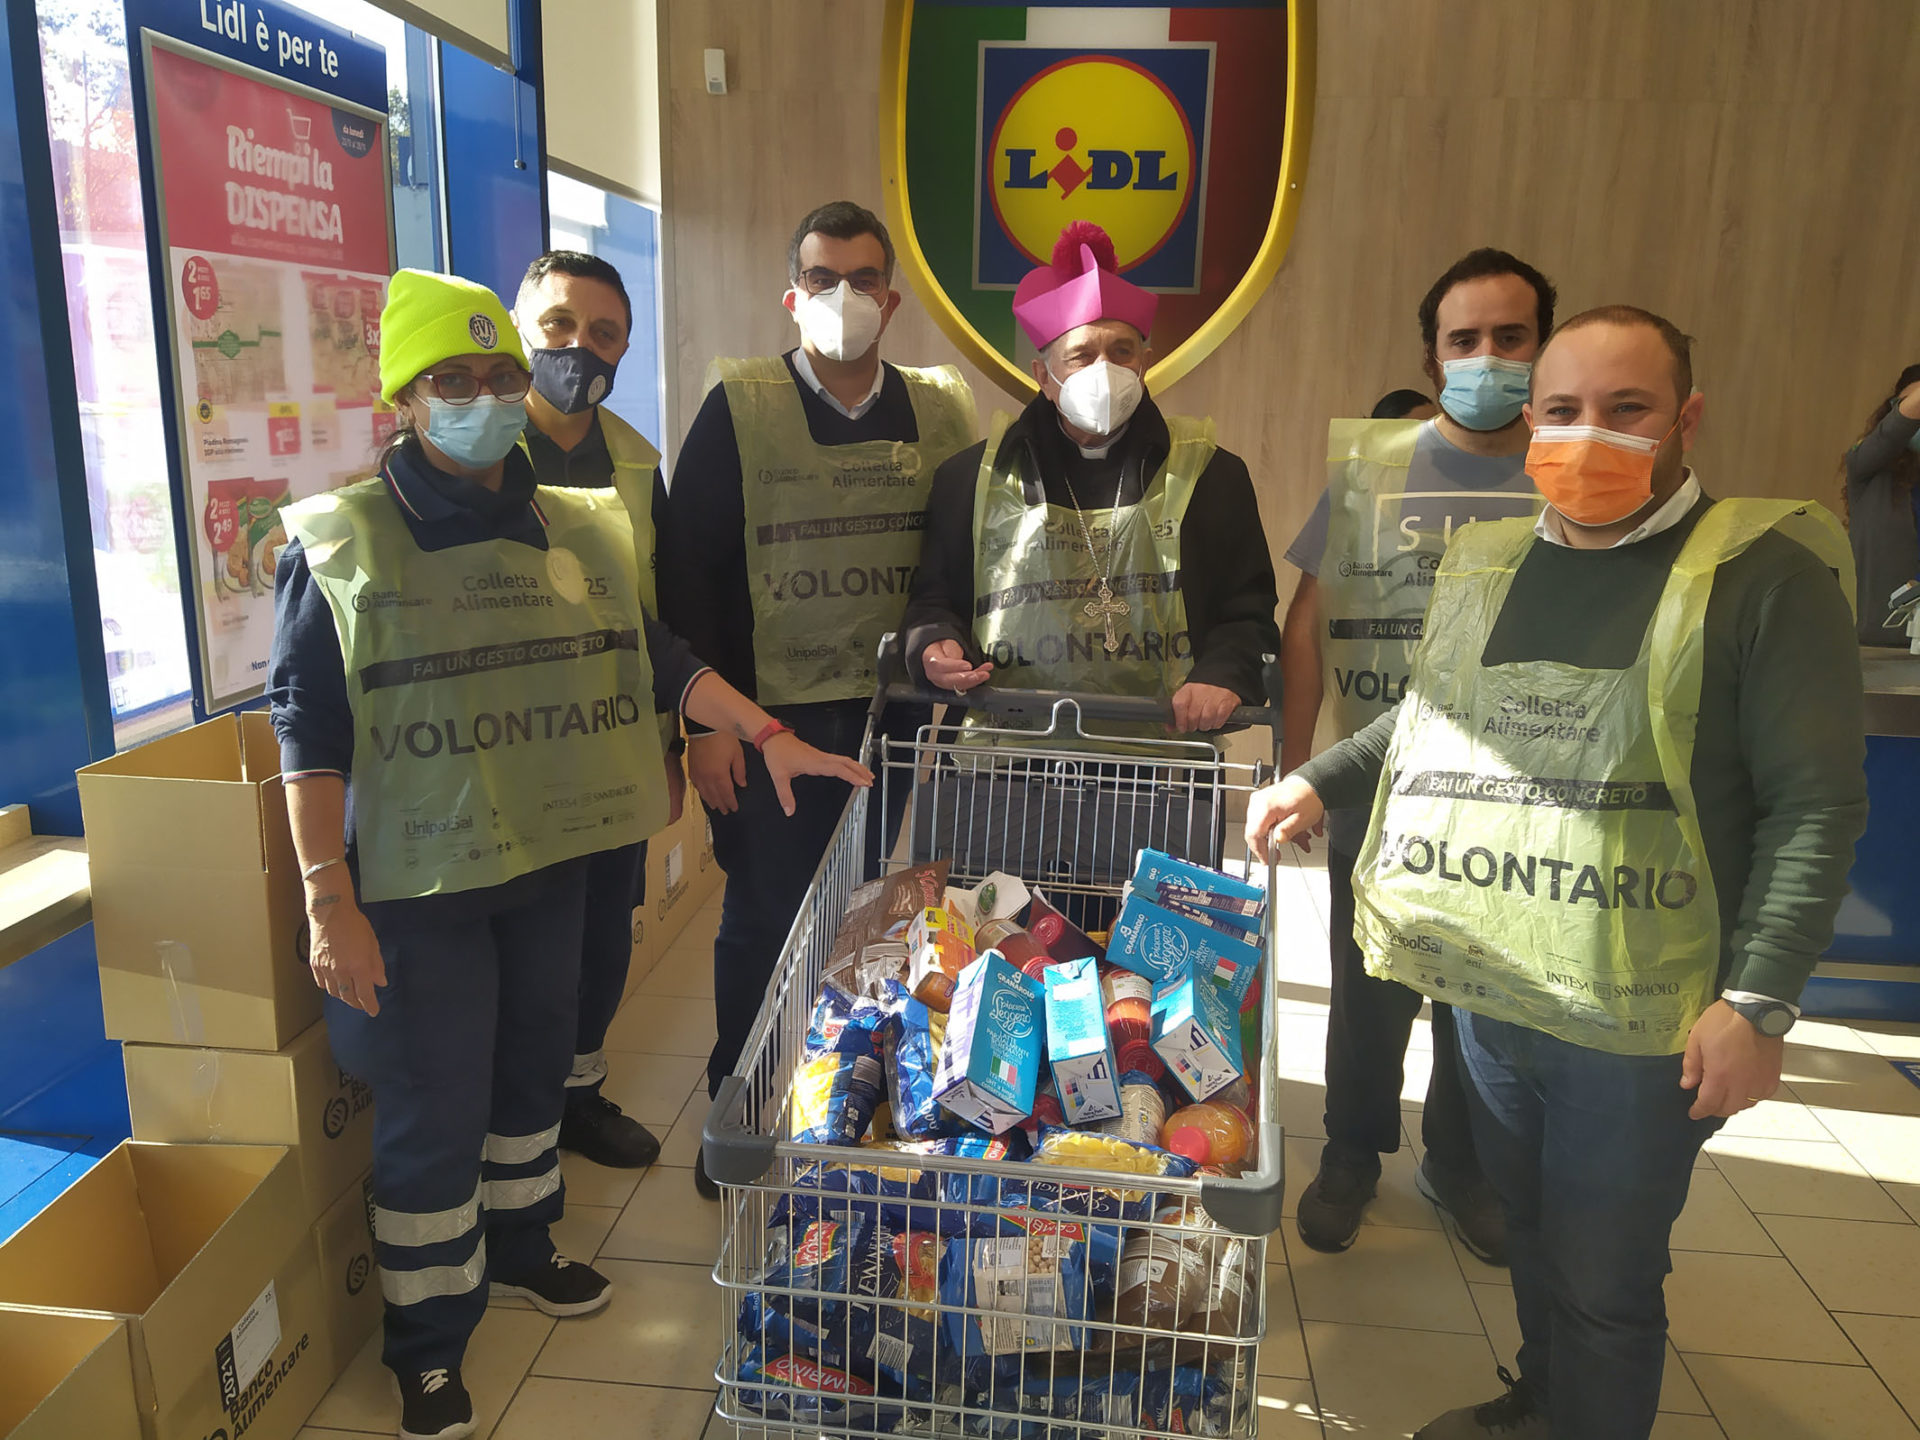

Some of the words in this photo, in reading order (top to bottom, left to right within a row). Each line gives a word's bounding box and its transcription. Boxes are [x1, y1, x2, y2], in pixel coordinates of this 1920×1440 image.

[200, 0, 247, 44] Lidl
[255, 9, 270, 52] è
[278, 28, 313, 68] per
[319, 38, 339, 78] te
[226, 125, 310, 190] Riempi
[312, 148, 334, 191] la
[225, 181, 344, 244] DISPENSA
[188, 260, 197, 284] 2
[832, 474, 917, 488] Alimentare
[210, 498, 219, 520] 2
[823, 521, 843, 534] UN
[845, 517, 887, 531] GESTO
[463, 571, 539, 592] Colletta
[584, 576, 609, 597] 25
[452, 590, 554, 614] Alimentare
[1368, 623, 1388, 635] FAI
[1390, 623, 1408, 635] UN
[412, 659, 442, 678] FAI
[445, 655, 472, 672] UN
[475, 646, 525, 668] GESTO
[529, 634, 606, 660] CONCRETO
[1500, 695, 1587, 720] Colletta
[370, 693, 640, 762] VOLONTARIO
[1482, 716, 1601, 744] Alimentare
[1455, 778, 1478, 795] UN
[1482, 779, 1541, 800] GESTO
[1544, 783, 1649, 805] CONCRETO
[404, 813, 474, 838] UnipolSai
[1380, 828, 1698, 911] VOLONTARIO
[1124, 913, 1146, 955] GRANAROLO
[1465, 959, 1482, 969] eni
[997, 972, 1035, 1001] GRANAROLO
[1546, 970, 1590, 993] INTESA
[1614, 982, 1680, 998] SANPAOLO
[221, 1356, 237, 1405] 2021
[229, 1359, 274, 1426] Banco
[233, 1333, 310, 1440] Alimentare
